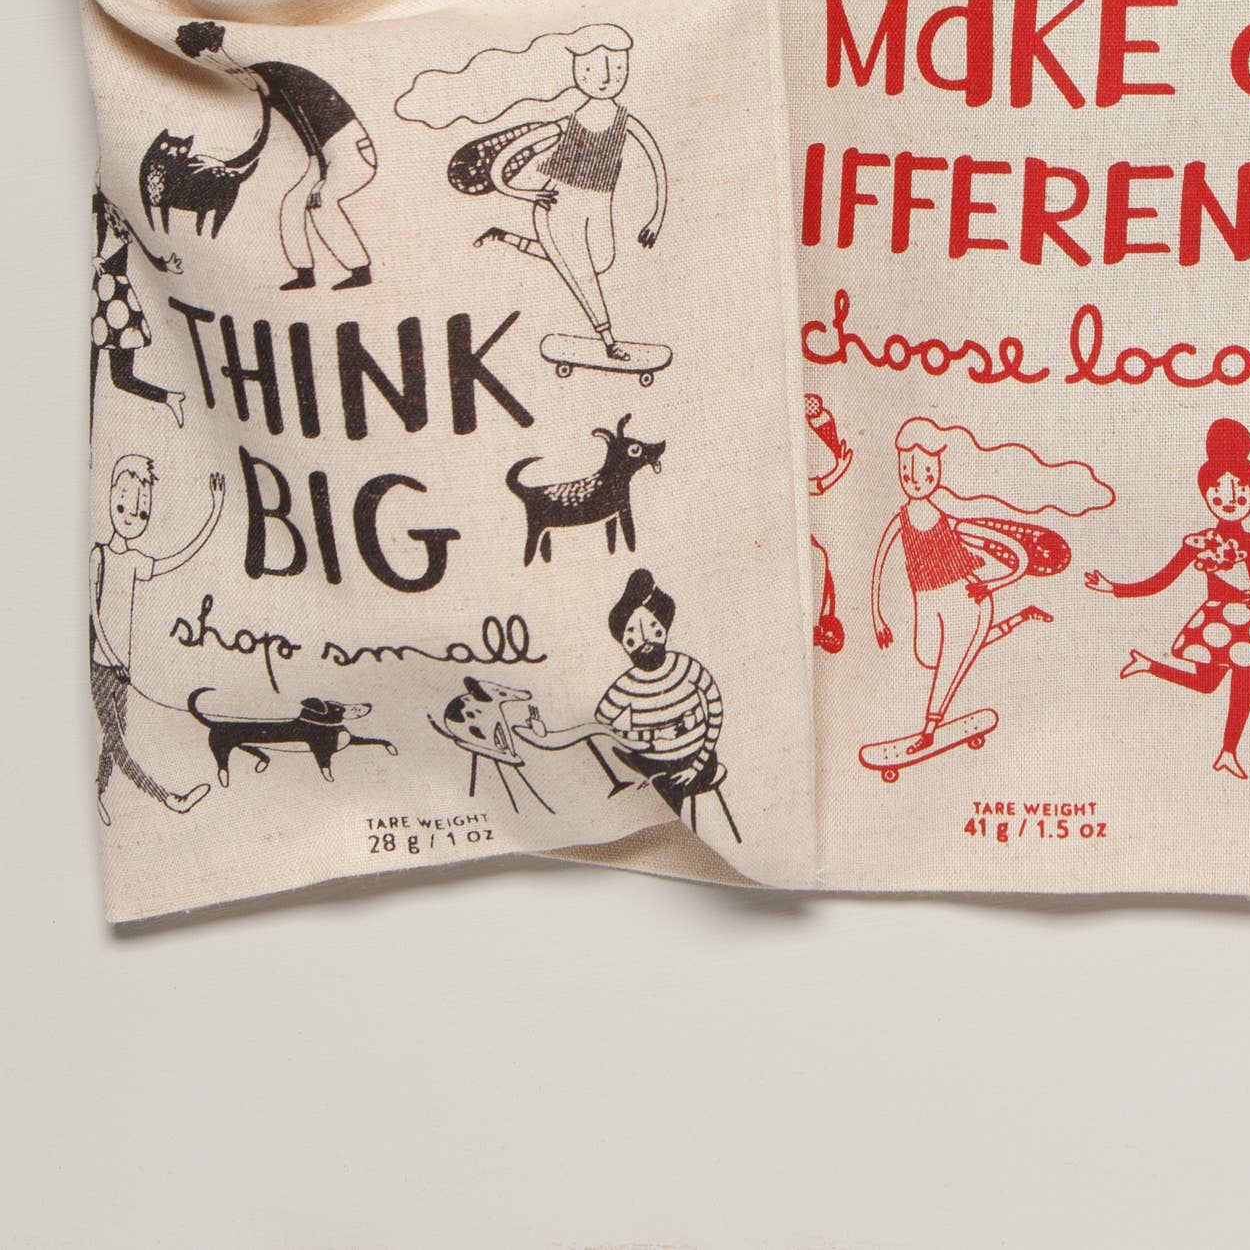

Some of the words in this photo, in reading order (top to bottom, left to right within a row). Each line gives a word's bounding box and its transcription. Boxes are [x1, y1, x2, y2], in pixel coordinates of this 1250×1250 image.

[801, 290, 1048, 384] choose
[168, 297, 535, 440] THINK
[239, 446, 460, 593] BIG
[170, 594, 300, 693] shop
[321, 615, 548, 665] small
[366, 816, 410, 830] TARE
[417, 813, 488, 830] WEIGHT
[964, 817, 987, 837] 41
[996, 822, 1009, 843] g
[1037, 820, 1069, 839] 1.5
[973, 801, 1016, 815] TARE
[1023, 802, 1097, 816] WEIGHT
[368, 833, 396, 854] 28
[408, 835, 420, 854] g
[446, 832, 456, 846] 1
